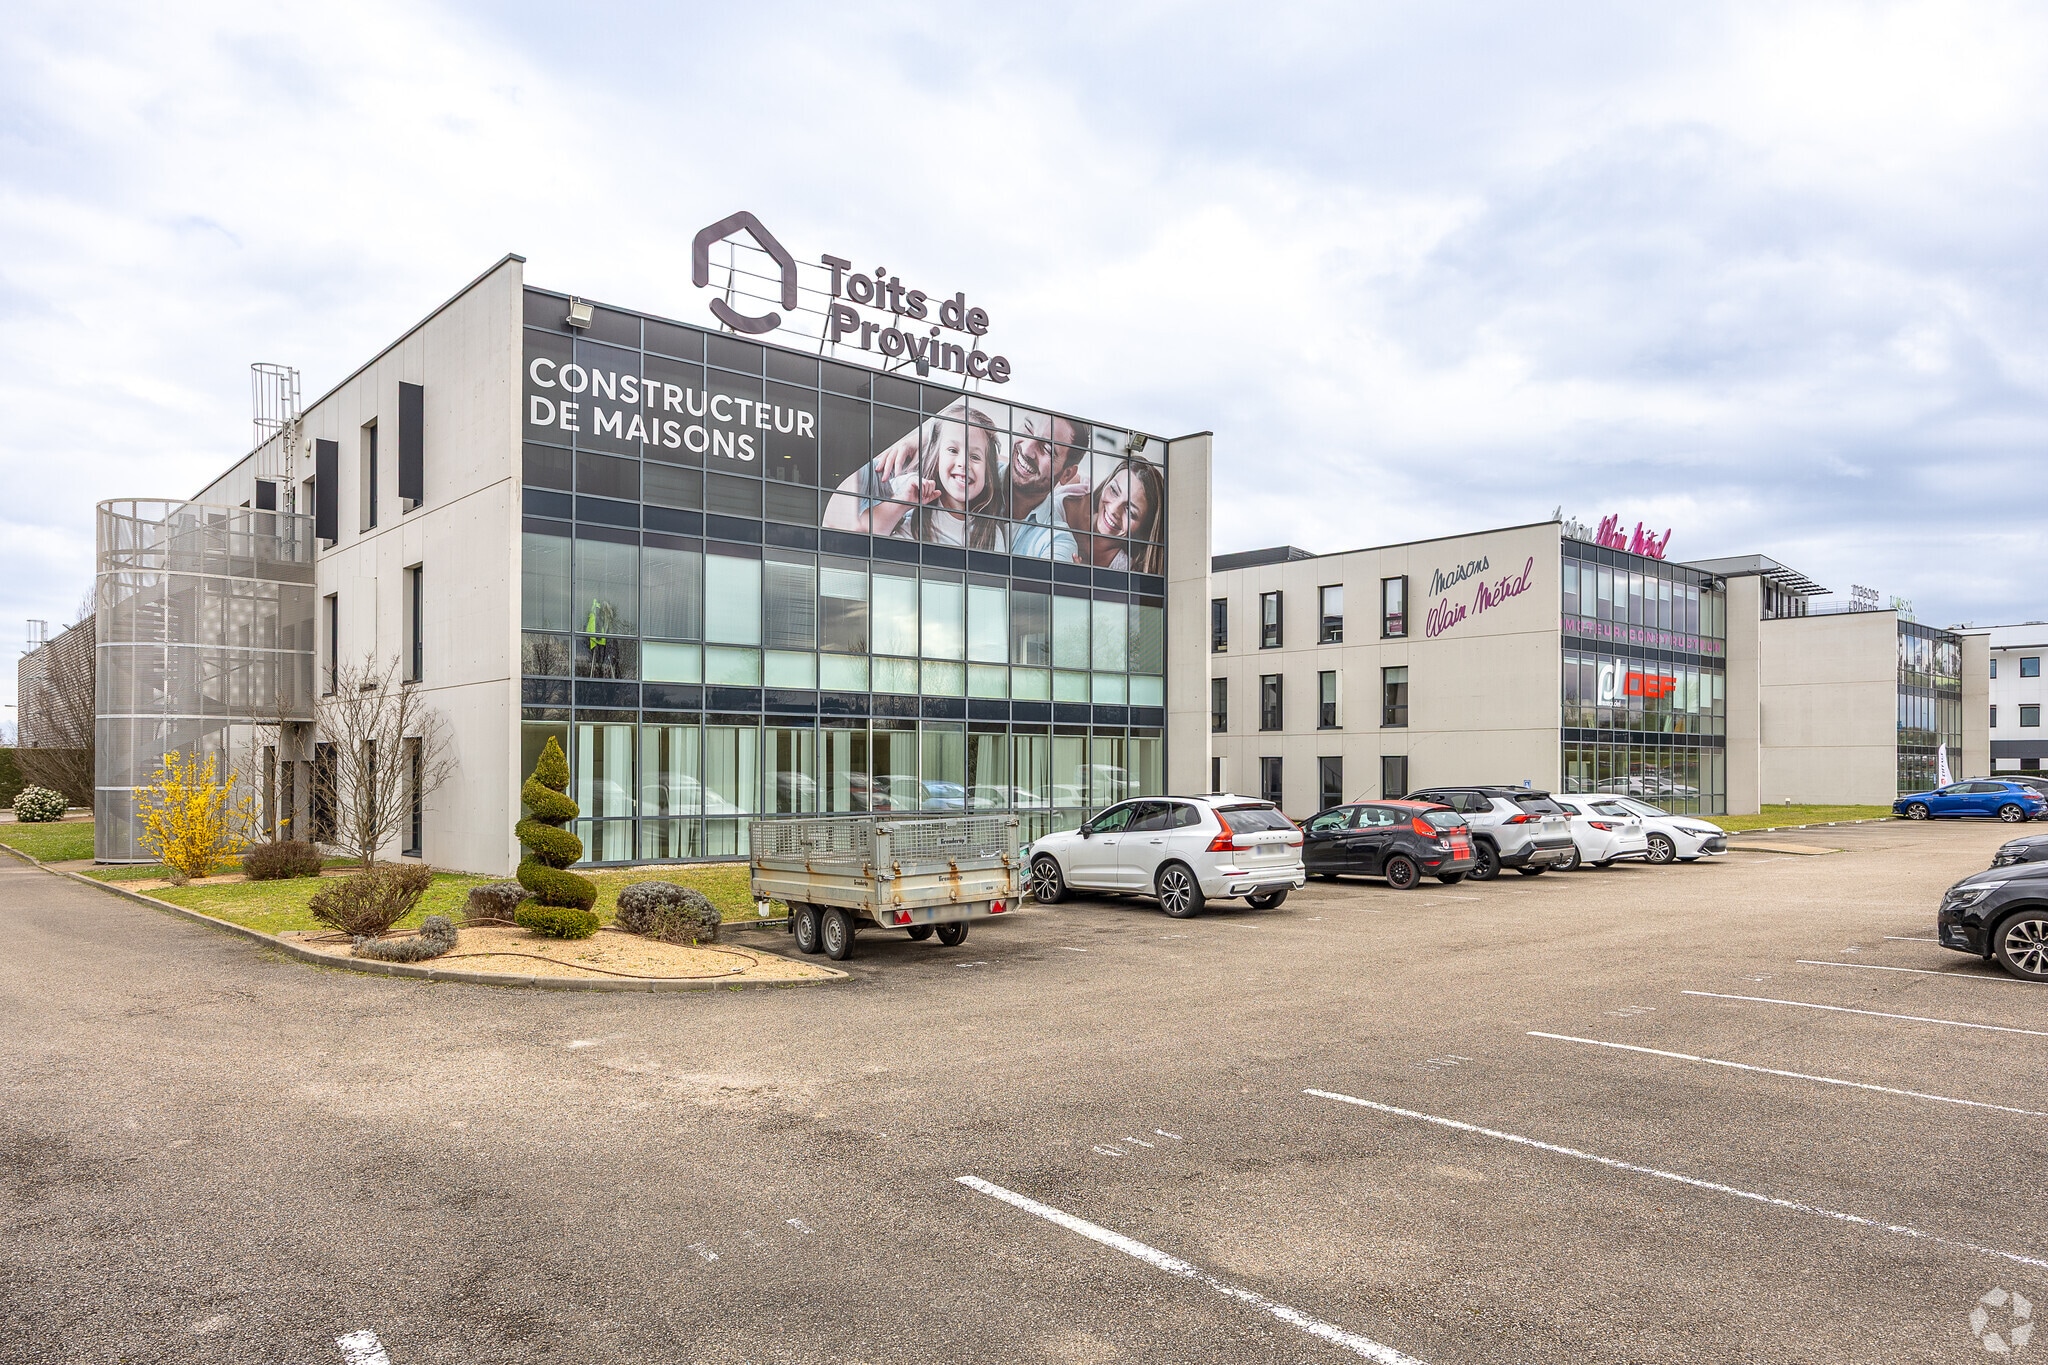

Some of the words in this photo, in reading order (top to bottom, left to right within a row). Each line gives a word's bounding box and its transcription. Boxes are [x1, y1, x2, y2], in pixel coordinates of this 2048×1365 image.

[821, 254, 927, 320] Toits
[940, 292, 990, 336] de
[831, 303, 1011, 384] Province
[528, 357, 816, 440] CONSTRUCTEUR
[529, 395, 580, 433] DE
[592, 409, 756, 462] MAISONS
[1429, 555, 1490, 598] Maisons
[1472, 556, 1534, 615] Métral
